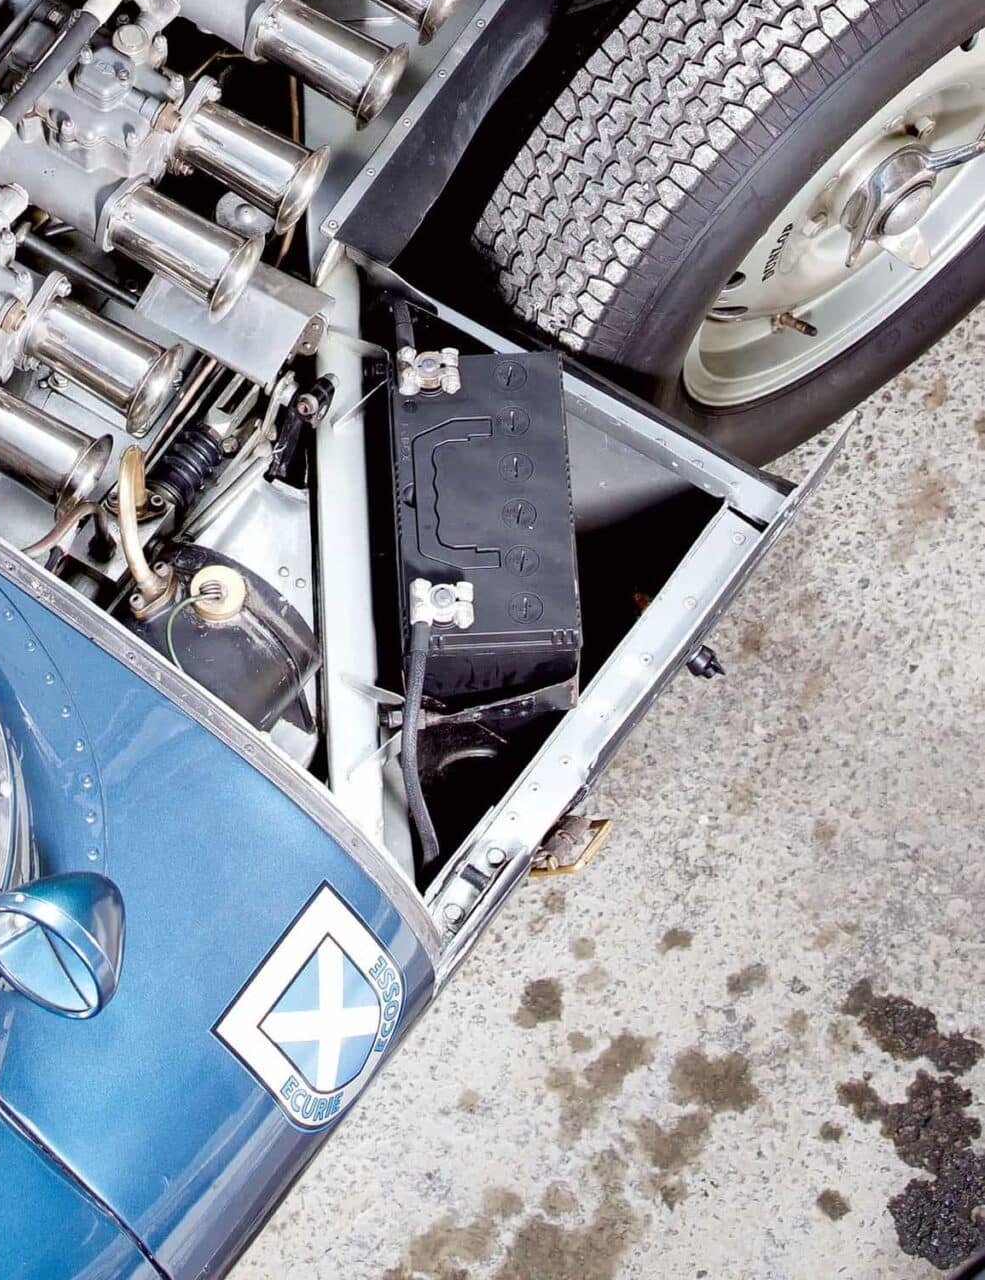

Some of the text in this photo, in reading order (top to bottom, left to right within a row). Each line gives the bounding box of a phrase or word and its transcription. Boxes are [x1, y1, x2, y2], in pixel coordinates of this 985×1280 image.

[762, 222, 793, 282] DUNLOP
[368, 956, 401, 1052] ECOSSE
[280, 1074, 344, 1121] ECURIE
